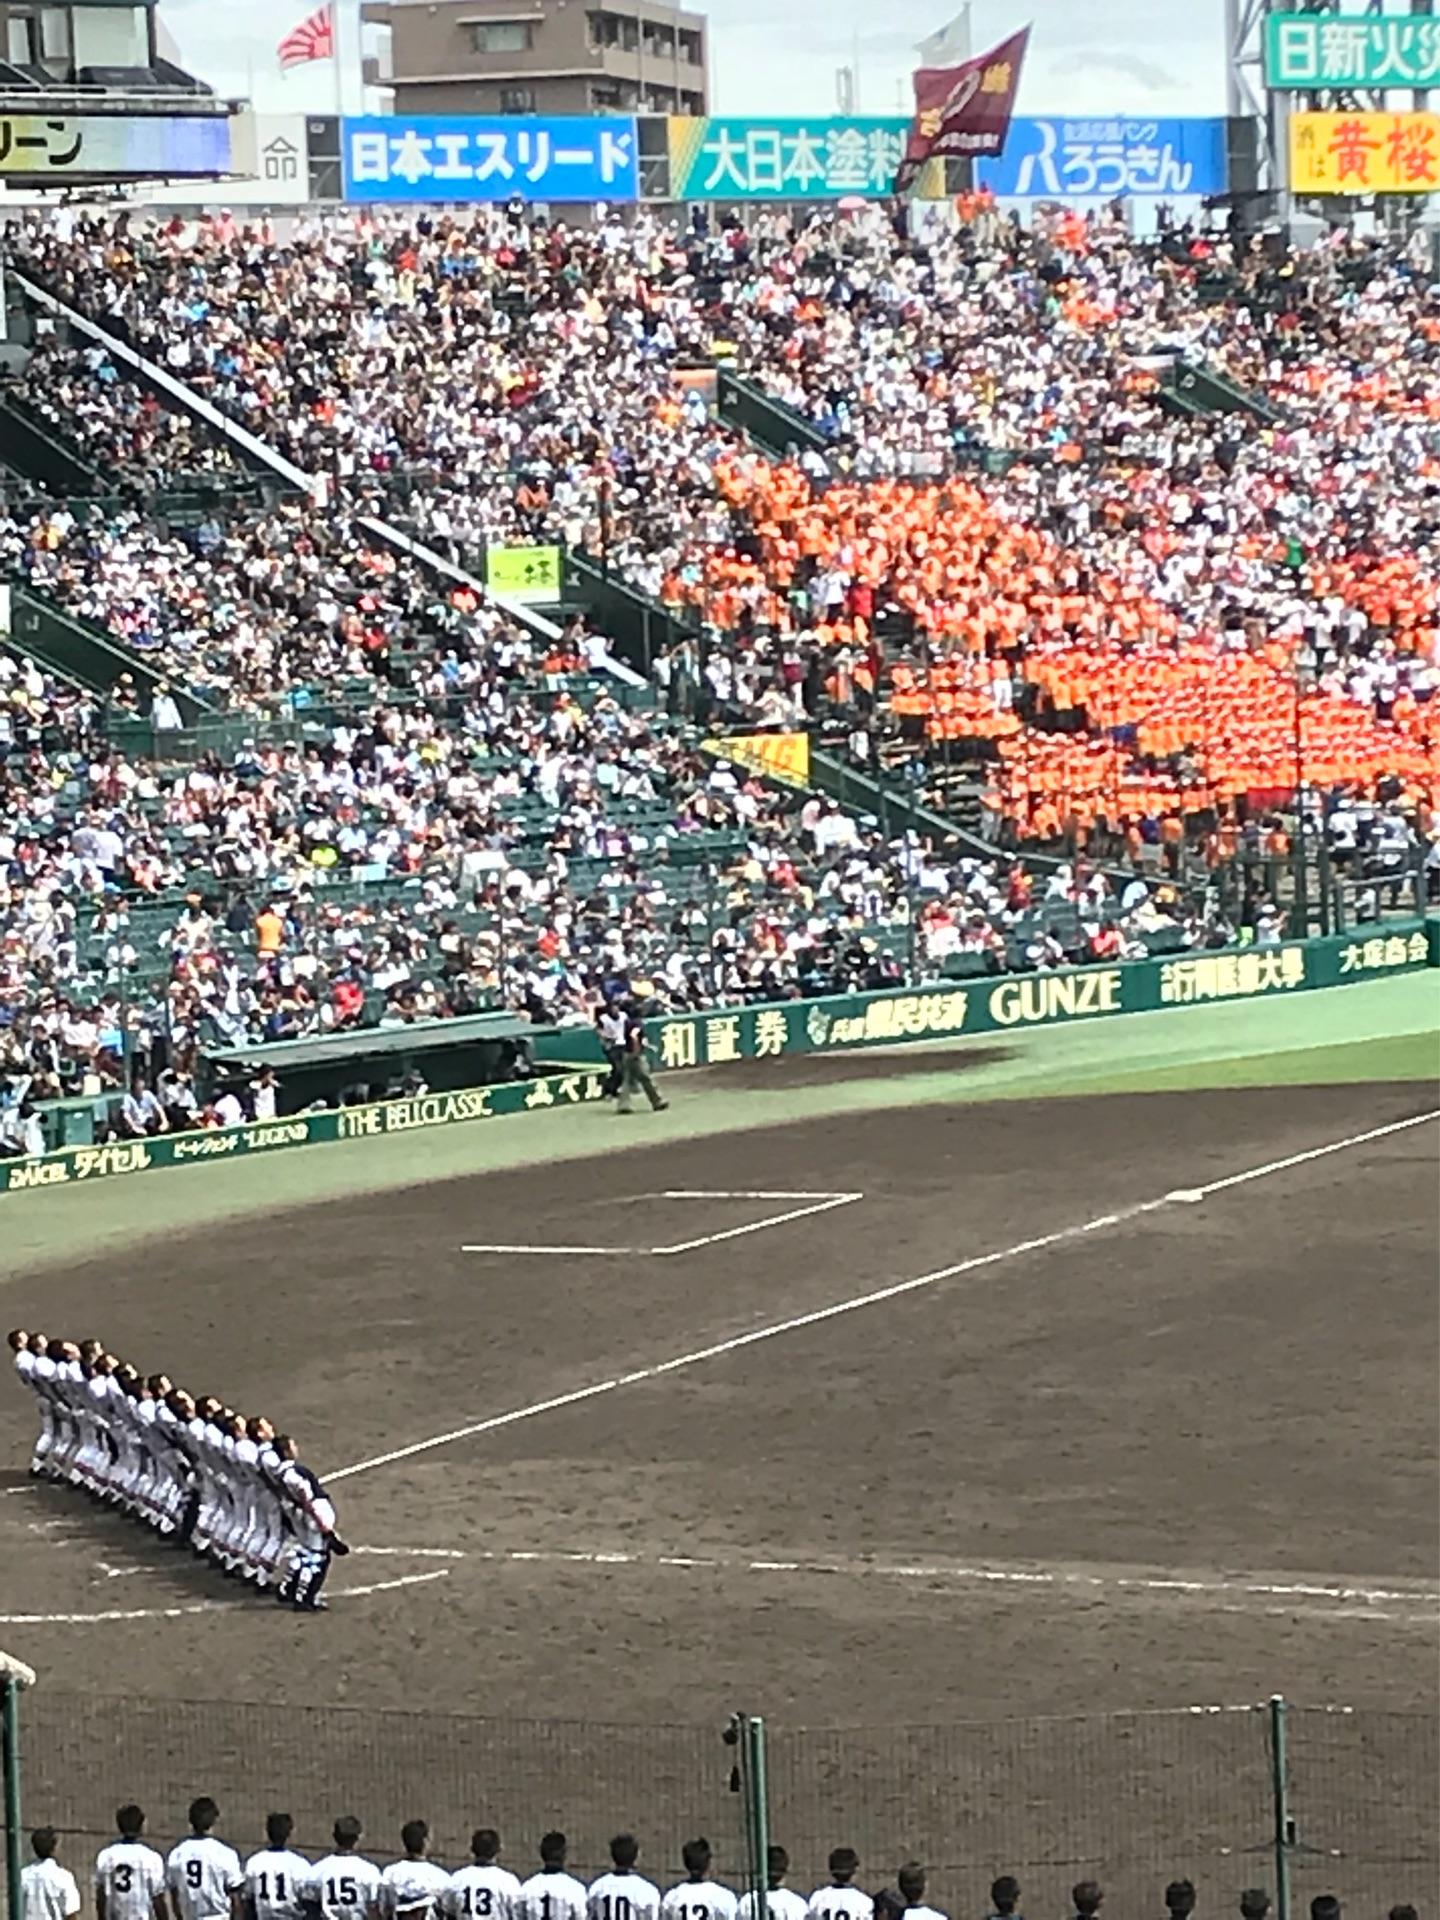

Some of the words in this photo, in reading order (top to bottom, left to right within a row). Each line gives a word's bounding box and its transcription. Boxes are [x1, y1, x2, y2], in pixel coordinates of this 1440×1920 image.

[351, 130, 632, 184] 日本エスリード
[703, 128, 907, 192] 大日本塗料
[1327, 117, 1438, 186] 黄桜
[1062, 143, 1193, 193] ろうきん
[989, 969, 1122, 1025] GUNZE
[346, 1109, 383, 1136] THE
[8, 1160, 70, 1189] DAICEL
[73, 1143, 152, 1179] ダイセル
[115, 1864, 132, 1893] 3
[187, 1860, 202, 1888] 9
[259, 1872, 287, 1901] 11
[326, 1876, 357, 1905] 15
[462, 1886, 492, 1915] 13
[540, 1893, 551, 1920] 1
[602, 1894, 631, 1920] 10
